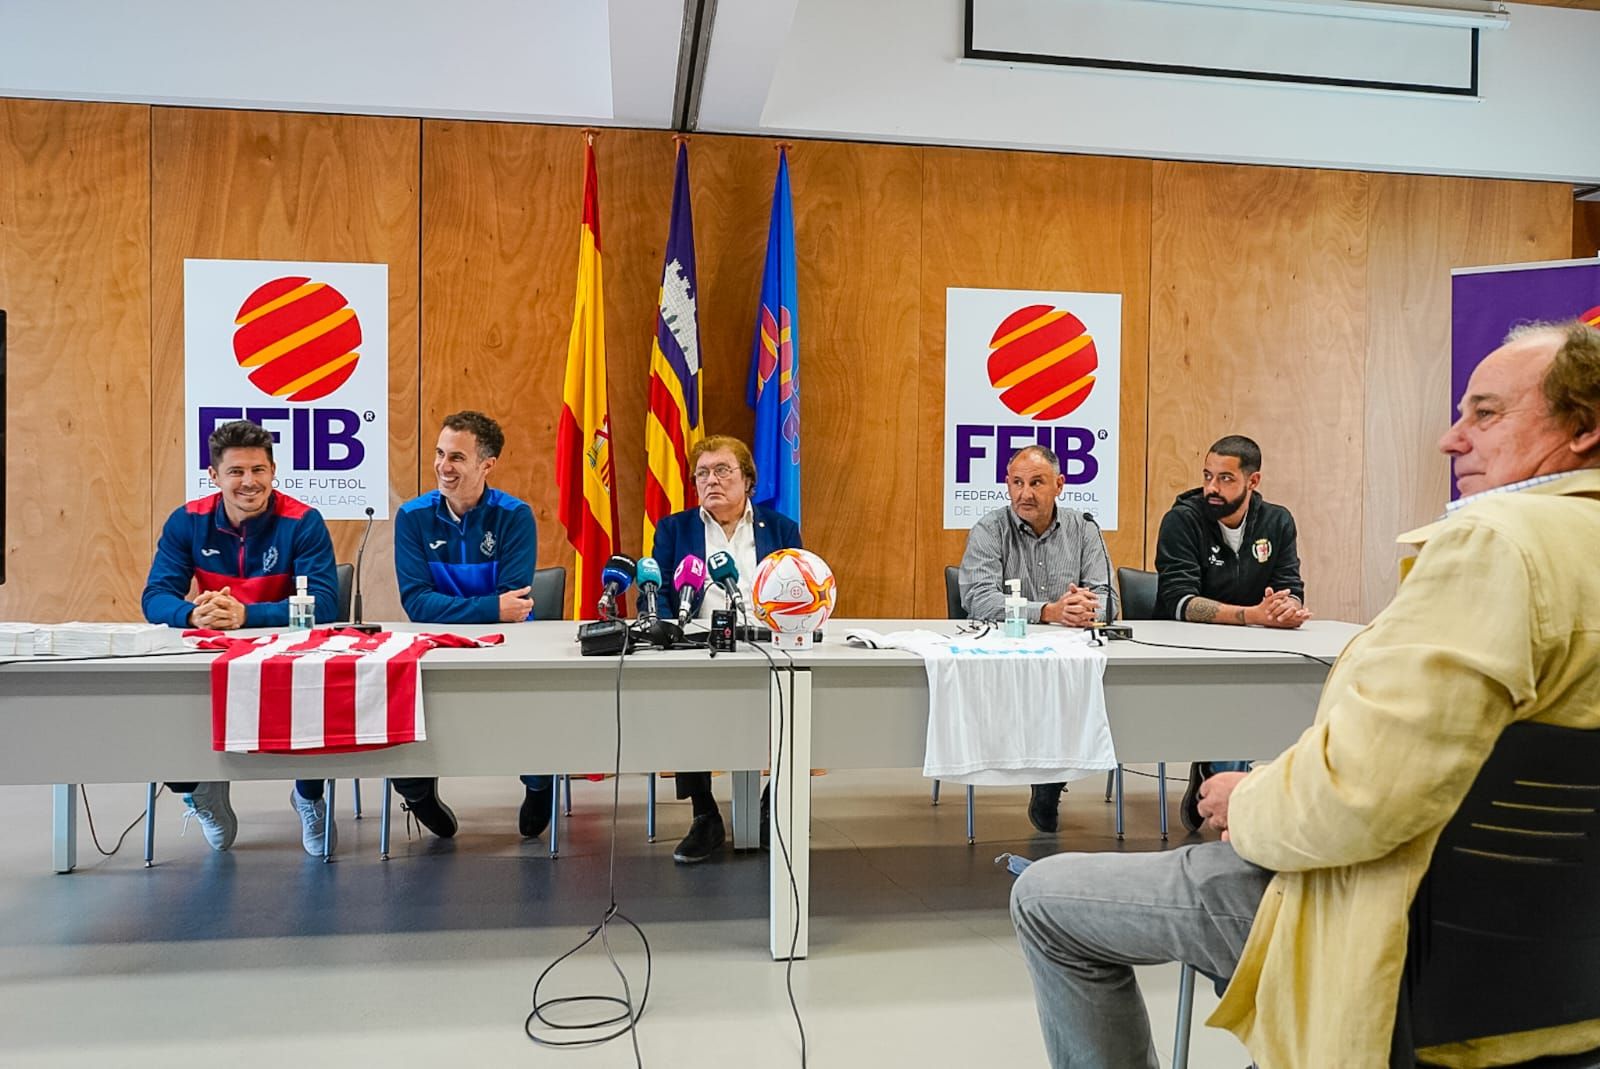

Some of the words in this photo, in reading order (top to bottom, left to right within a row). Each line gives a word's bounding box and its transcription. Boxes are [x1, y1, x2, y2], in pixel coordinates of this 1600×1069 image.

[285, 478, 303, 489] DE
[309, 478, 367, 489] FUTBOL
[300, 495, 367, 506] BALEARS
[955, 490, 1012, 501] FEDERAC
[1058, 491, 1099, 502] UTBOL
[954, 505, 971, 516] DE
